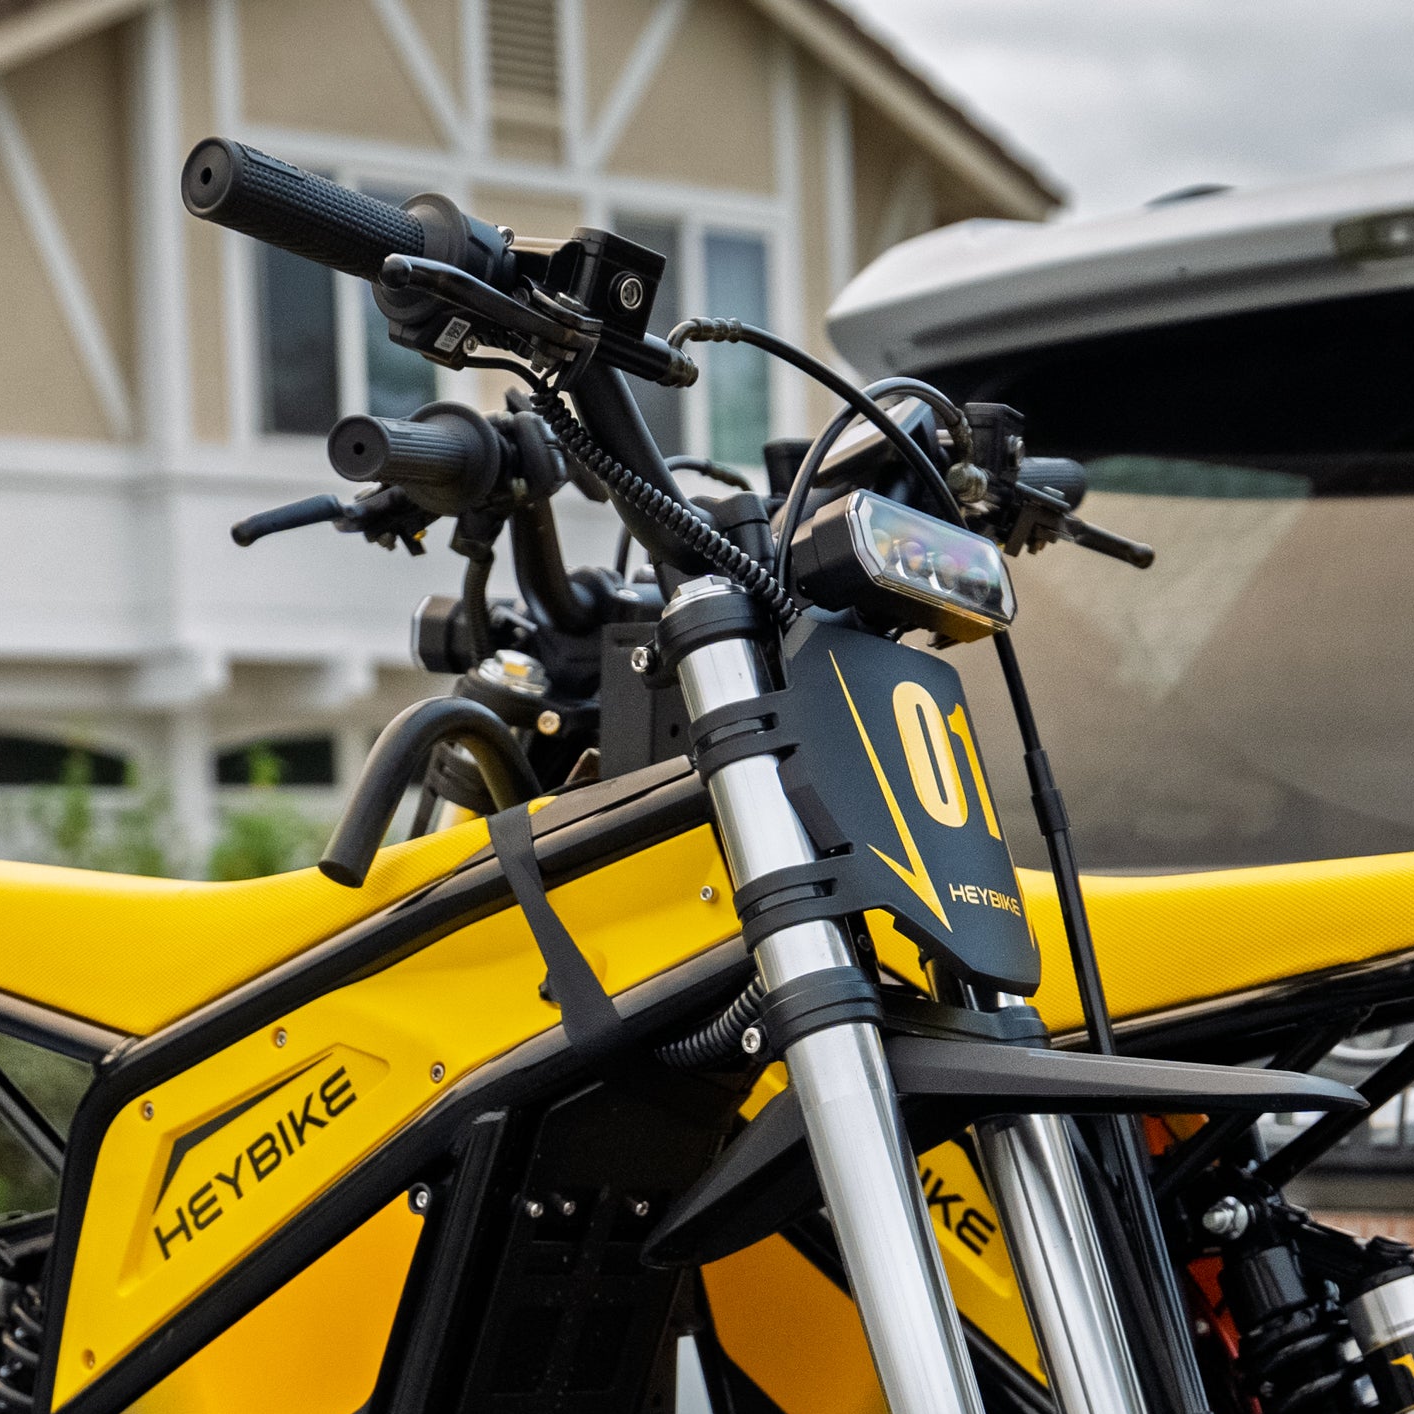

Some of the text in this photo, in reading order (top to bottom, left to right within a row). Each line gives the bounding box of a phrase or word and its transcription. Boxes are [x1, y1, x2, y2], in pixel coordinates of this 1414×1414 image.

[892, 681, 1002, 841] 01
[948, 883, 1022, 917] HEYBIKE
[153, 1065, 358, 1261] HEYBIKE
